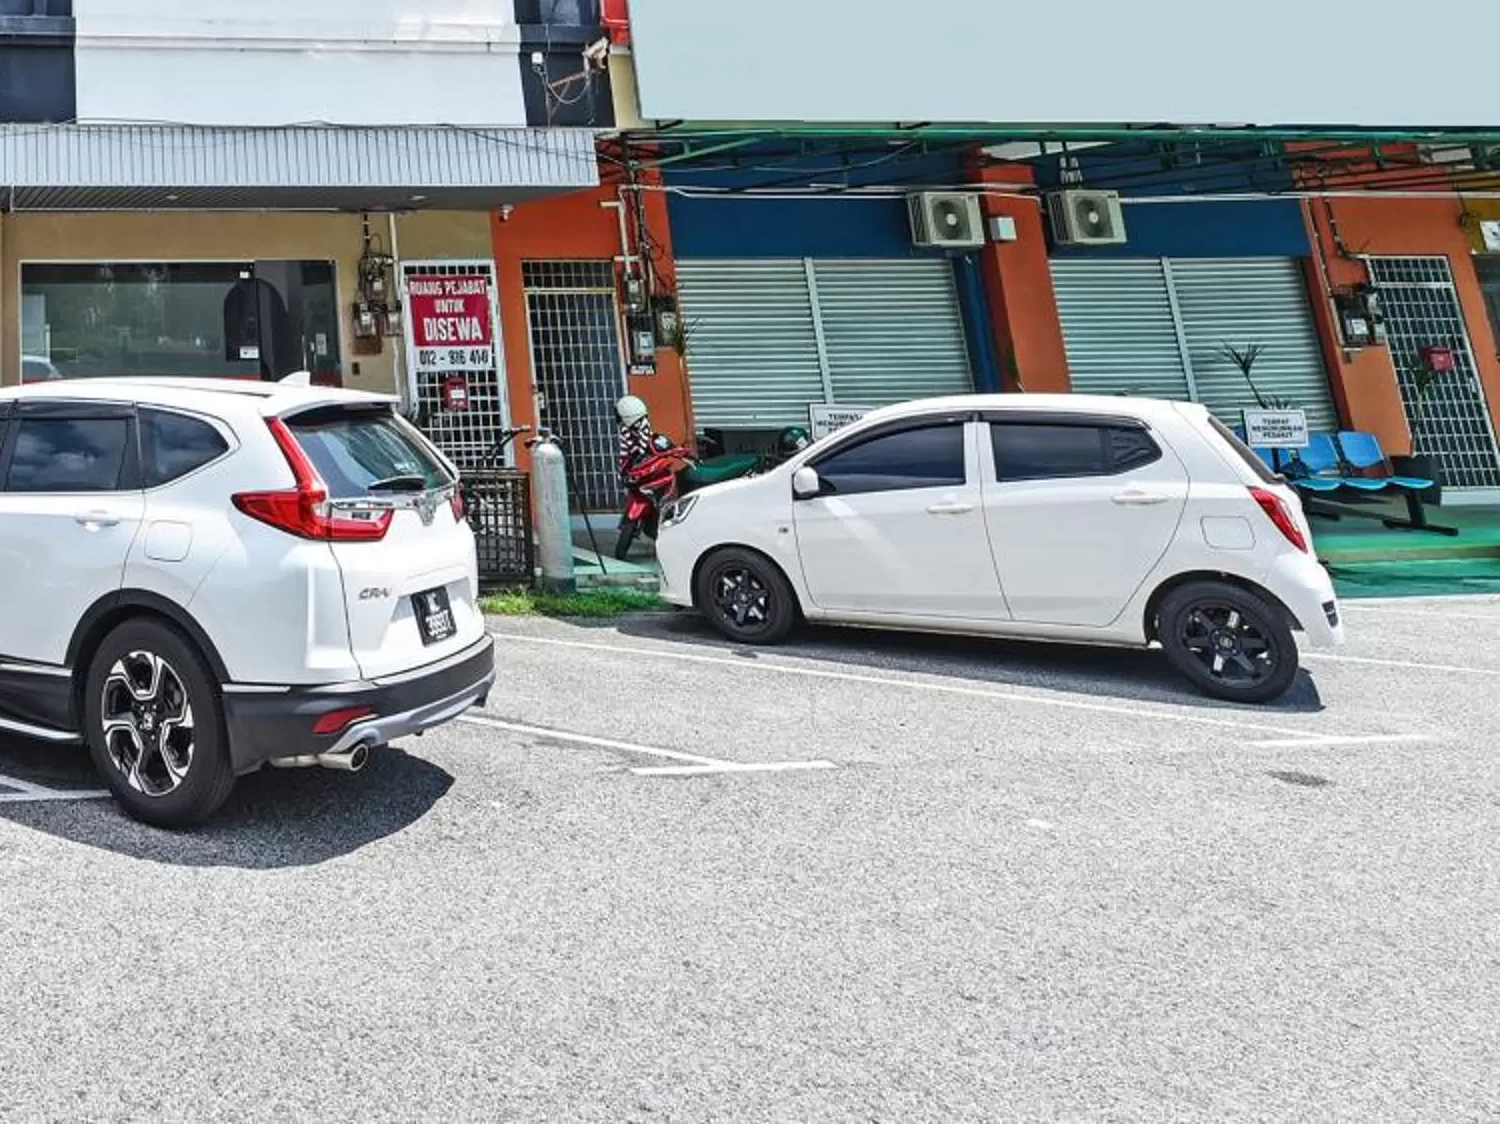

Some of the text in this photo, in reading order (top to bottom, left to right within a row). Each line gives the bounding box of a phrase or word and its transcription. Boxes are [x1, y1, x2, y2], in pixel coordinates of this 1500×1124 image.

[409, 279, 486, 295] RUANG PEJABAT
[434, 299, 465, 313] UNTUK
[423, 316, 484, 342] DISEWA
